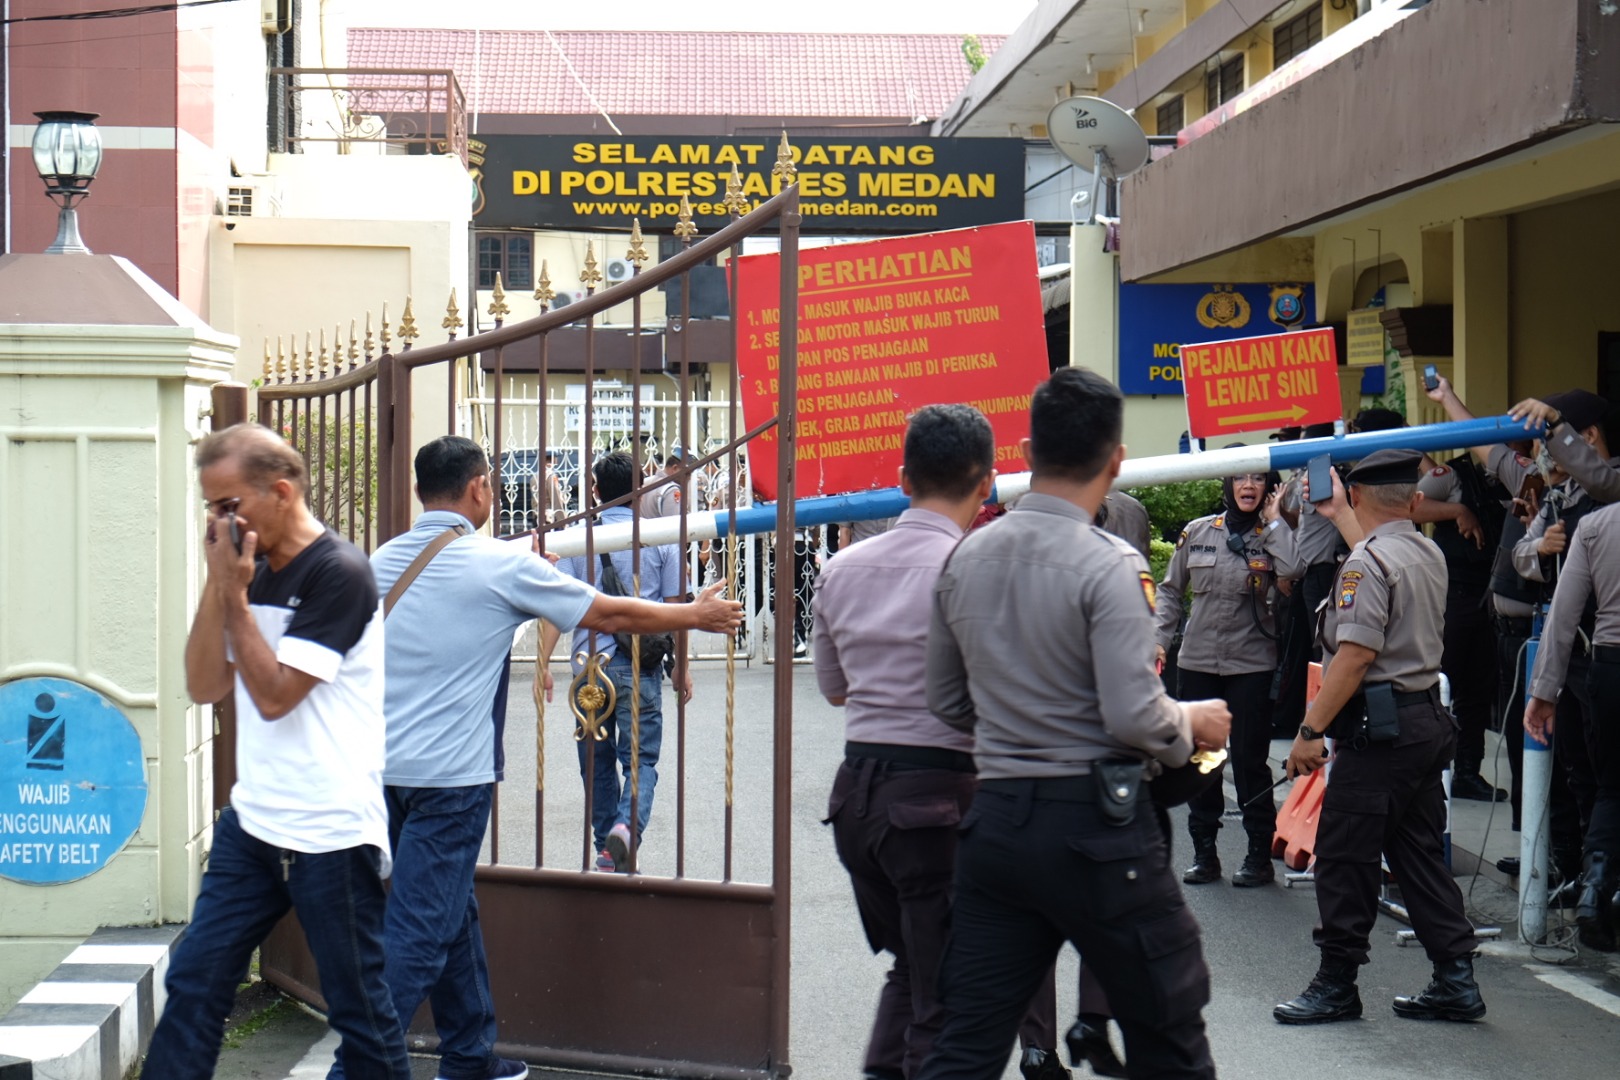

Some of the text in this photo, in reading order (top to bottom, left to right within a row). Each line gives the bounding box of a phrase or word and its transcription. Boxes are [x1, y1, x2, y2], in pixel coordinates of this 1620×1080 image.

[572, 142, 765, 164] SELAMAT
[512, 170, 551, 195] DI
[858, 172, 996, 198] MEDAN
[797, 246, 972, 289] PERHATIAN
[747, 310, 760, 327] 1.
[804, 299, 851, 320] MASUK
[852, 295, 894, 315] WAJIB
[895, 289, 933, 310] BUKA
[934, 285, 971, 305] KACA
[749, 304, 1000, 350] 2. SEDA MOTOR MASUK WAJIB TURUN
[823, 346, 851, 365] POS
[852, 336, 930, 361] PENJAGAAN
[1153, 343, 1179, 358] MO
[1185, 334, 1331, 378] PEJALAN KAKI
[755, 379, 768, 396] 3.
[825, 365, 880, 388] BAWAAN
[881, 360, 923, 381] WAJIB
[925, 358, 940, 376] DI
[941, 351, 999, 374] PERIKSA
[1149, 366, 1183, 381] POL
[1204, 367, 1319, 408] LEWAT SINI
[817, 387, 895, 412] PENJAGAAN
[824, 411, 862, 434] GRAB
[863, 405, 907, 430] ANTAR
[819, 433, 902, 459] DIBENARKAN
[18, 783, 71, 805] WAJIB
[0, 813, 112, 835] NGGUNAKAN
[0, 843, 101, 864] AFETY BELT
